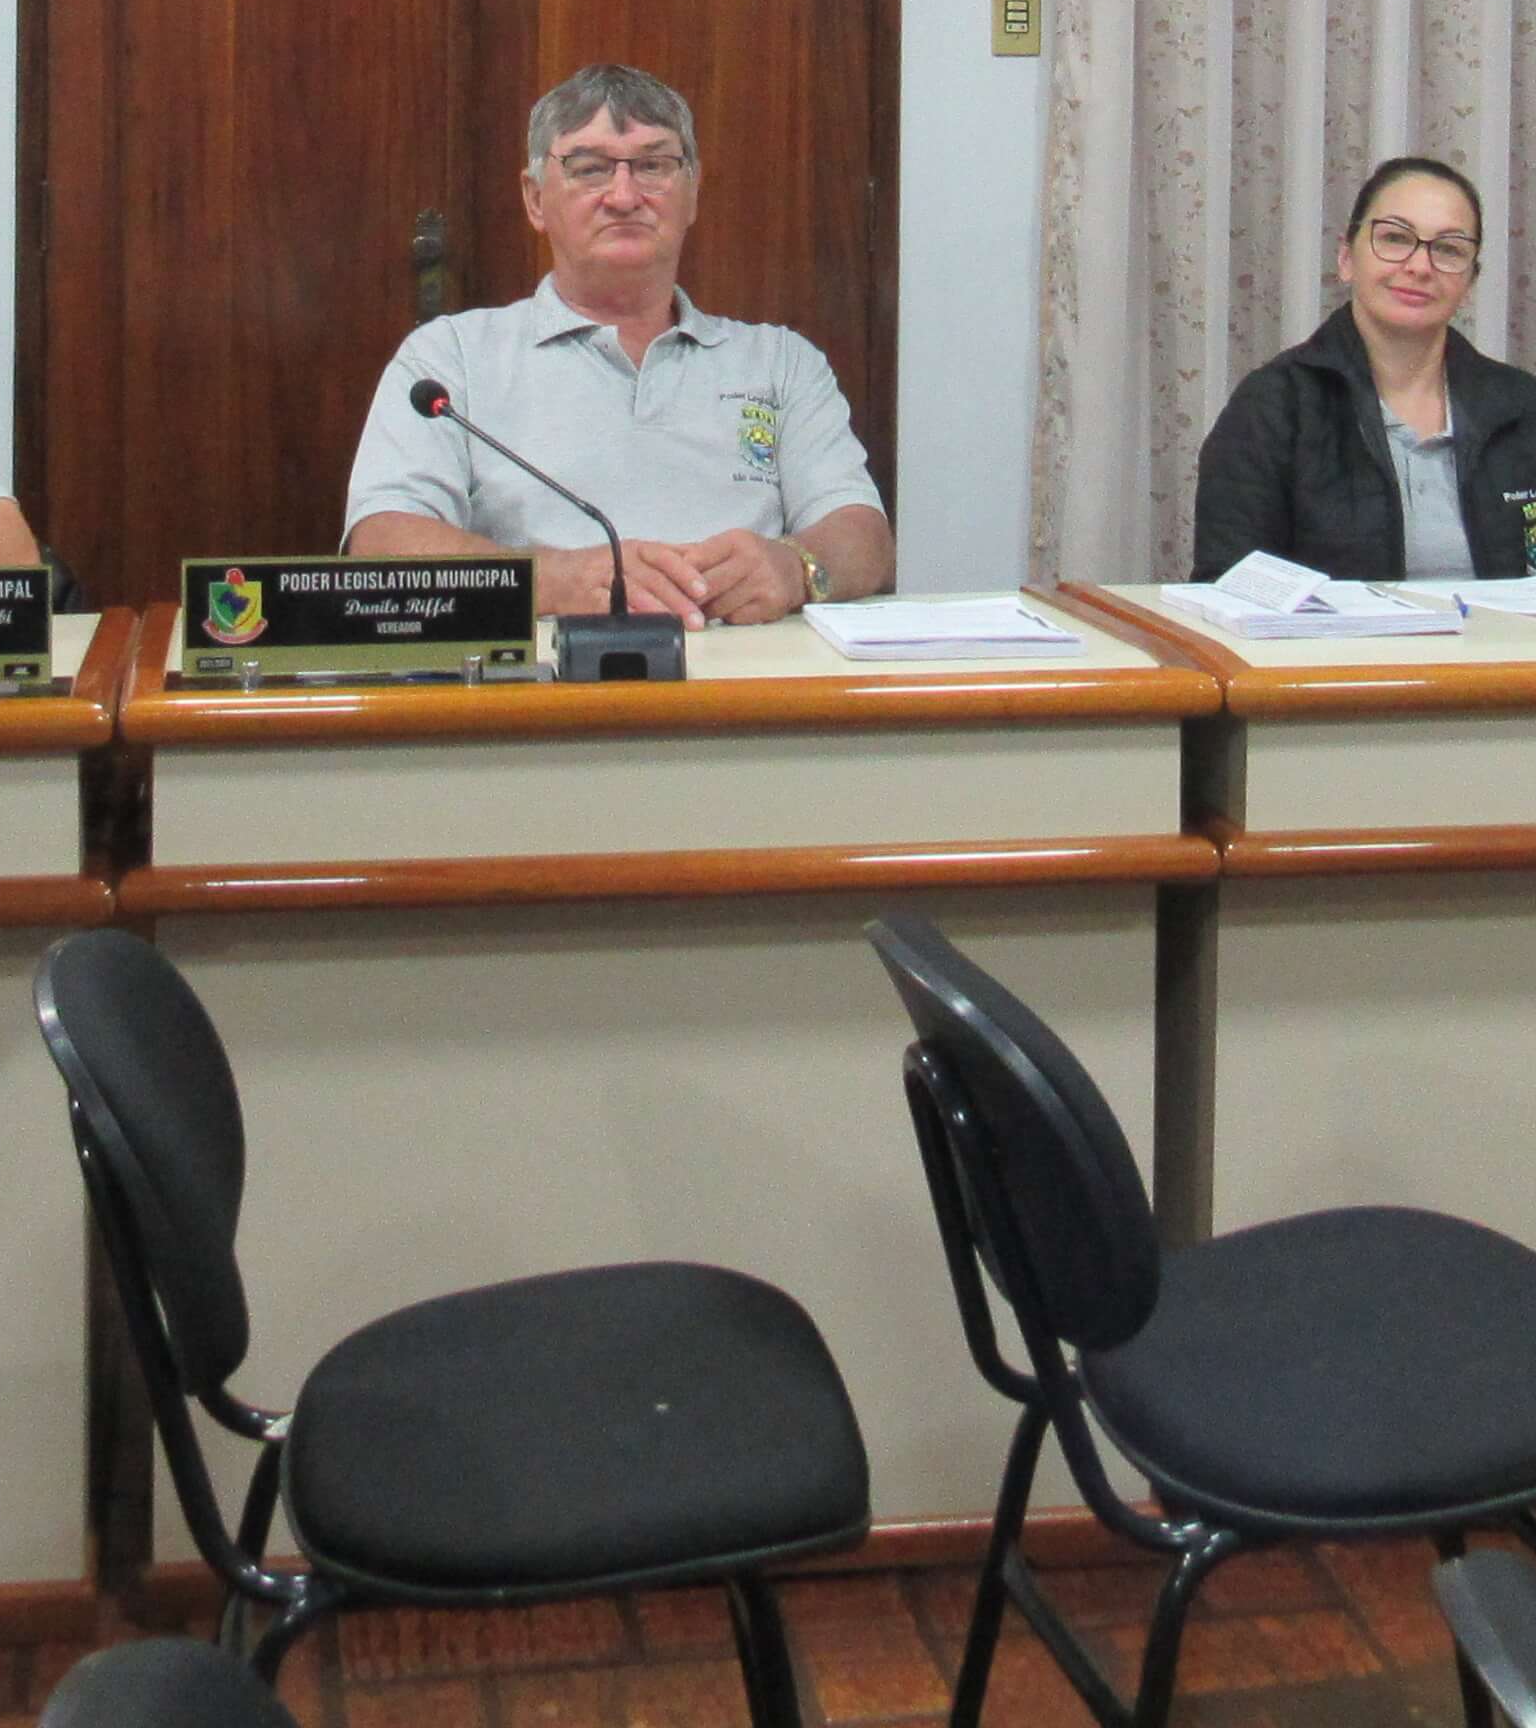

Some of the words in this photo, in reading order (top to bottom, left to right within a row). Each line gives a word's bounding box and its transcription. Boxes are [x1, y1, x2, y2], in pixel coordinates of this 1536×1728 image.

[280, 572, 330, 592] PODER
[334, 570, 432, 591] LEGISLATIVO
[436, 569, 519, 589] MUNICIPAL
[344, 598, 400, 616] Danilo
[404, 597, 456, 617] Riffel
[376, 621, 423, 633] VEREADOR
